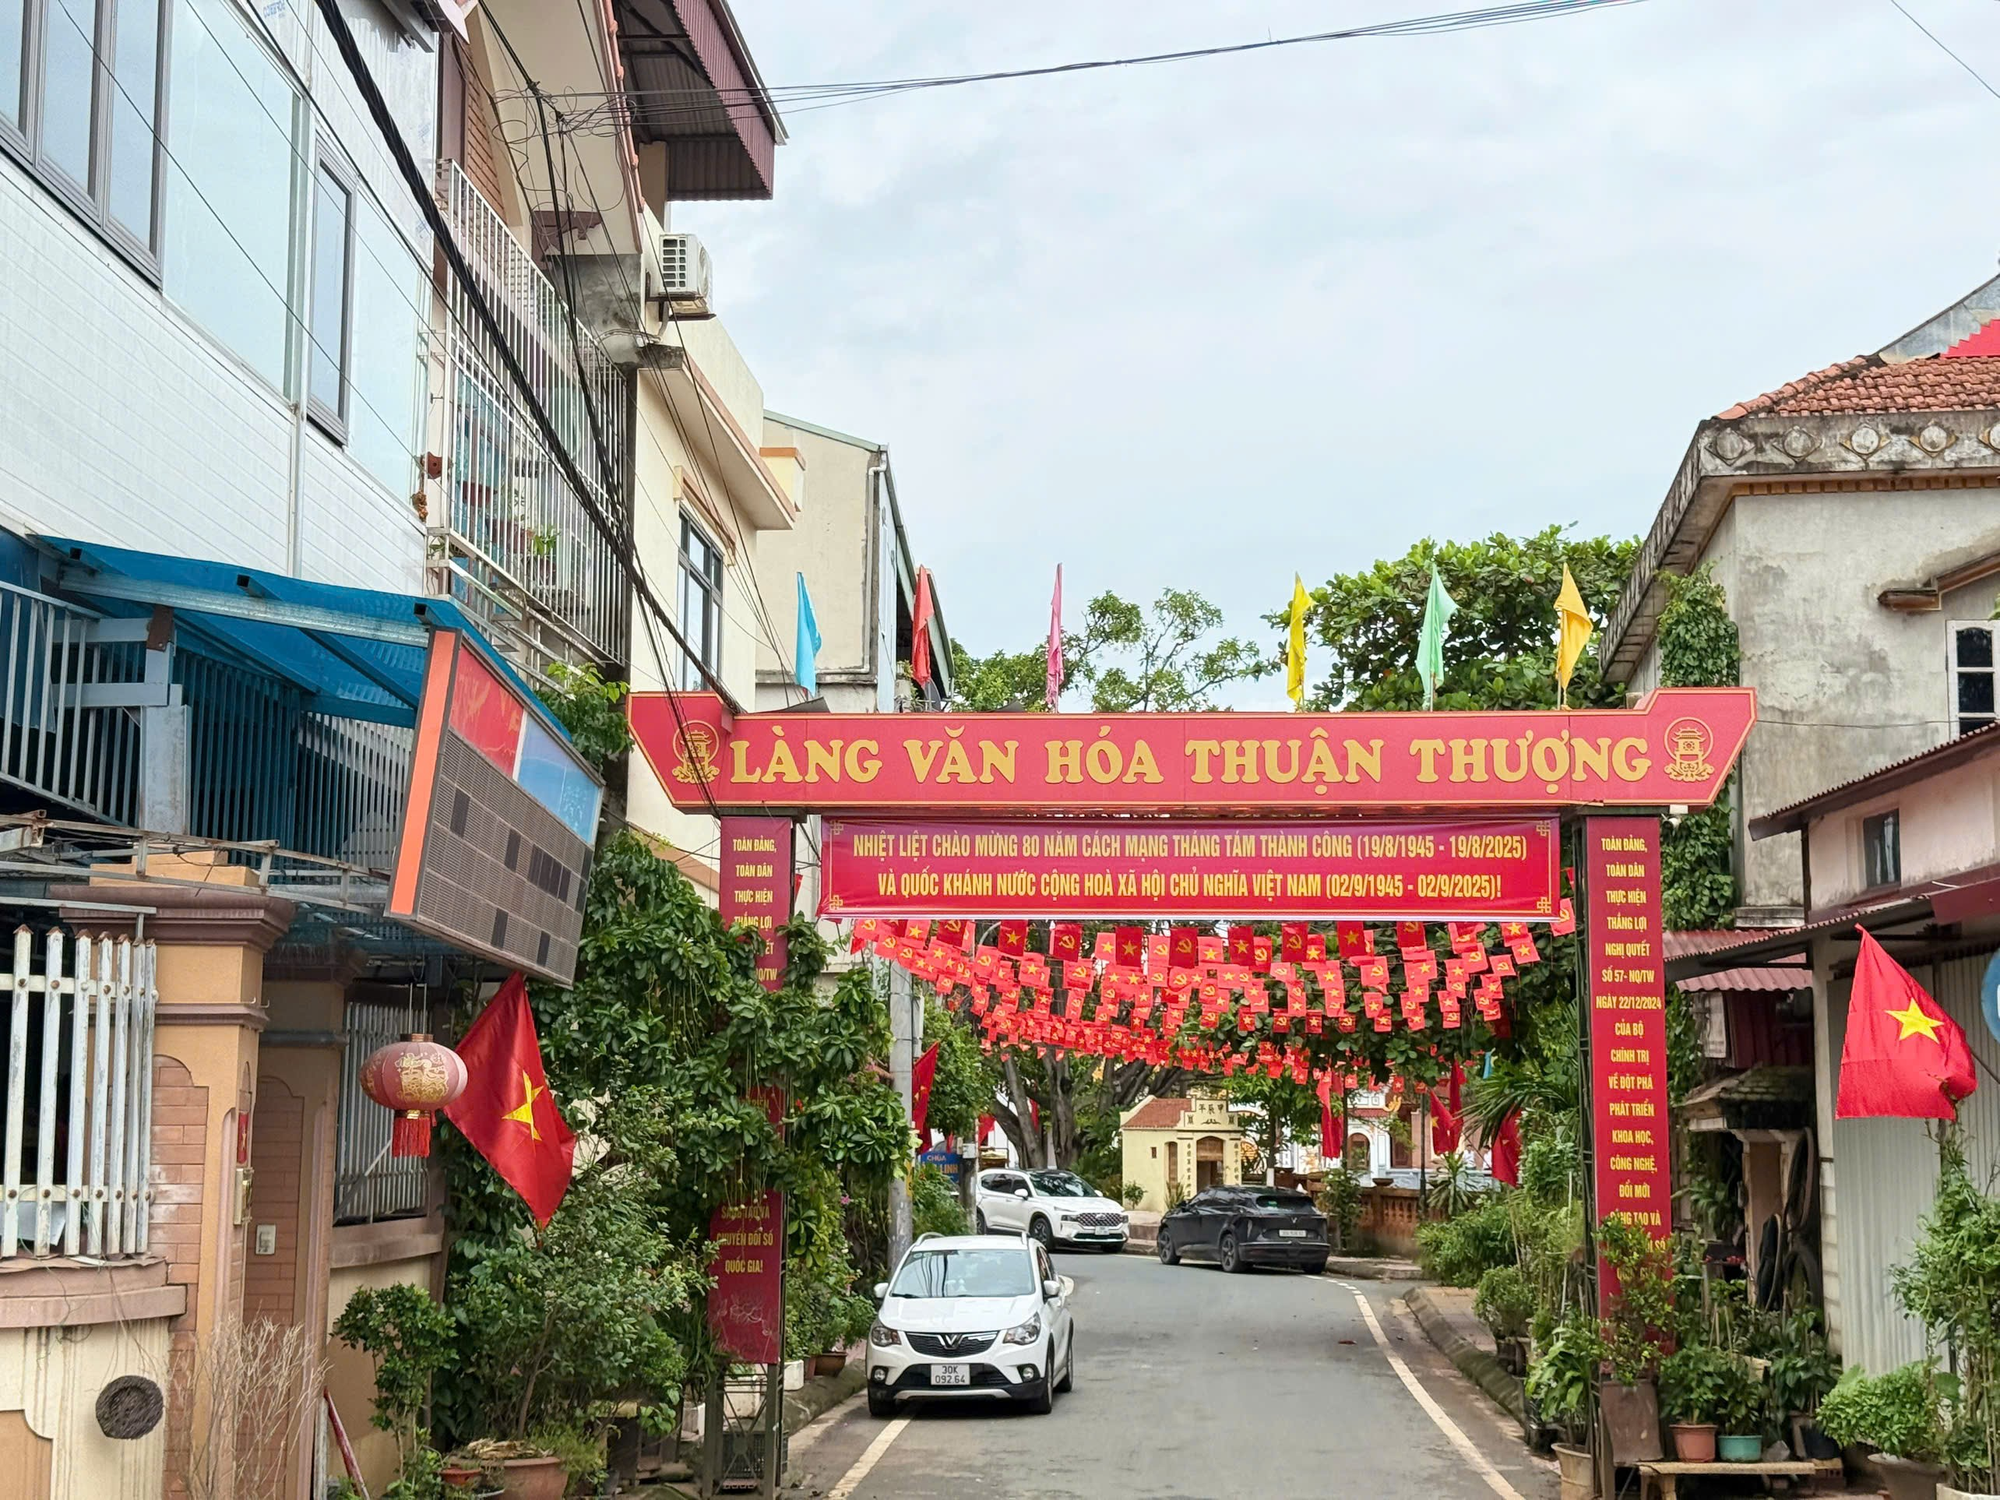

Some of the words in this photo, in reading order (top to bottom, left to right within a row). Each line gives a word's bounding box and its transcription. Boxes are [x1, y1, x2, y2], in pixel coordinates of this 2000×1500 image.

[729, 725, 883, 783] LÀNG
[903, 724, 1019, 784] VĂN
[1044, 725, 1164, 784] HÓA
[1185, 727, 1385, 795] THUẬN
[1409, 729, 1652, 794] THƯỢNG
[733, 835, 753, 852] TOÀN
[754, 834, 777, 854] ĐẢNG,
[853, 830, 895, 862] NHIỆT
[899, 830, 928, 862] LIỆT
[932, 830, 970, 858] CHÀO
[975, 830, 1018, 858] MỪNG
[1022, 834, 1040, 858] 80
[1044, 830, 1078, 858] NĂM
[1082, 830, 1121, 858] CÁCH
[1125, 834, 1168, 862] MẠNG
[1172, 830, 1221, 858] THÁNG
[1224, 831, 1256, 858] TÁM
[1260, 831, 1308, 858] THÀNH
[1312, 831, 1353, 858] CÔNG
[1357, 834, 1434, 860] (19/8/1945
[1449, 834, 1527, 861] 19/8/2025)
[1601, 836, 1622, 851] TOÀN
[1623, 834, 1648, 853] ĐẢNG,
[736, 862, 756, 877] TOÀN
[757, 862, 773, 877] DÂN
[1606, 862, 1627, 877] TOÀN
[1628, 863, 1645, 878] DÂN
[878, 868, 897, 896] VÀ
[901, 865, 939, 899] QUỐC
[943, 869, 992, 896] KHÁNH
[997, 869, 1036, 896] NƯỚC
[1040, 869, 1080, 901] CỘNG
[1084, 869, 1114, 896] HOÀ
[1118, 869, 1137, 896] XÃ
[1142, 869, 1165, 901] HỘI
[1170, 866, 1199, 897] CHỦ
[1203, 869, 1248, 897] NGHĨA
[1252, 869, 1283, 902] VIỆT
[1287, 873, 1321, 897] NAM
[1326, 874, 1403, 900] (02/9/1945
[1418, 874, 1501, 900] 02/9/2025)!
[734, 889, 754, 906] THỰC
[755, 888, 773, 906] HIỆN
[1606, 889, 1626, 906] THỰC
[1628, 888, 1646, 906] HIỆN
[760, 915, 773, 931] LỢI
[1607, 912, 1632, 930] THẮNG
[1634, 916, 1647, 933] LỢI
[1605, 943, 1624, 959] NGHỊ
[1626, 938, 1650, 957] QUYẾT
[1602, 965, 1613, 982] SỐ
[1596, 993, 1617, 1009] NGÀY
[1618, 995, 1662, 1010] 22/12/2024
[1615, 1018, 1631, 1036] CỦA
[1633, 1020, 1644, 1038] BỘ
[1636, 1049, 1650, 1066] TRỊ
[1631, 1098, 1655, 1117] TRIỂN
[1612, 1130, 1634, 1144] KHOA
[1635, 1130, 1654, 1148] HỌC,
[1610, 1155, 1632, 1170] CÔNG
[1633, 1155, 1657, 1174] NGHỆ,
[1619, 1180, 1633, 1198] ĐỔI
[1635, 1182, 1650, 1198] MỚI
[725, 1254, 745, 1274] QUỐC
[747, 1260, 763, 1273] GIA!
[942, 1365, 959, 1375] 30K
[935, 1375, 965, 1384] 092.64
